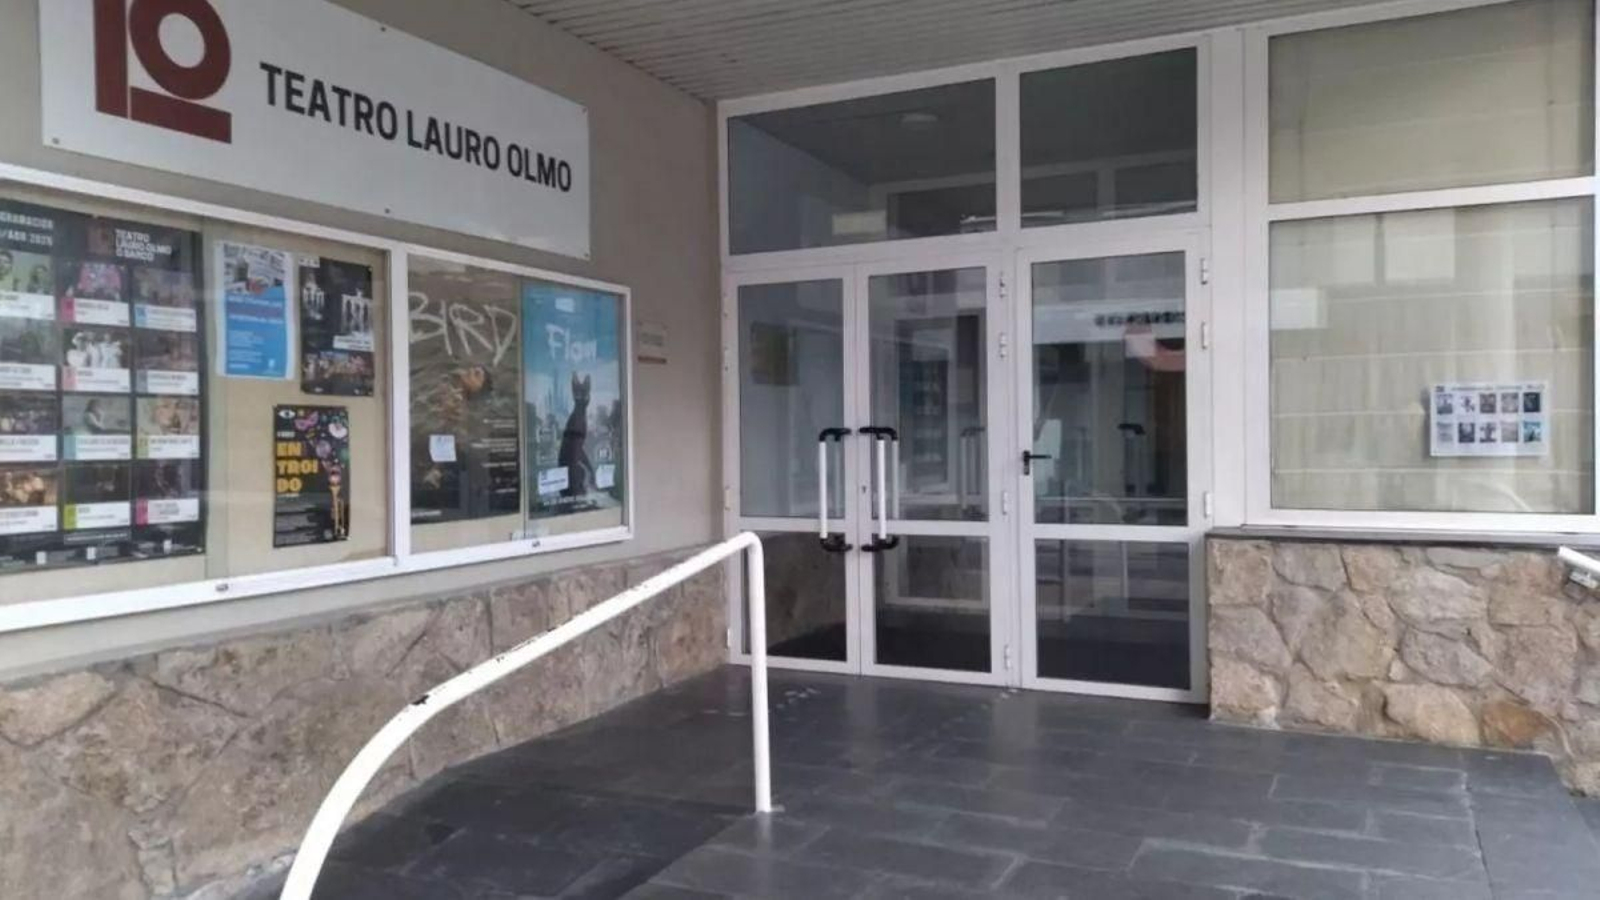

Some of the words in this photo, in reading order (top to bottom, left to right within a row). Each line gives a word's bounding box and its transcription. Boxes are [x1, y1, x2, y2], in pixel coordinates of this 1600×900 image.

[260, 62, 397, 140] TEATRO
[407, 109, 500, 170] LAURO
[507, 144, 572, 192] OLMO
[115, 229, 150, 242] TEATRO
[115, 237, 145, 250] LAURO
[146, 243, 172, 255] OLMO
[408, 291, 517, 367] BIRD
[545, 323, 597, 364] Flow
[277, 442, 302, 457] EN
[277, 478, 302, 493] DO
